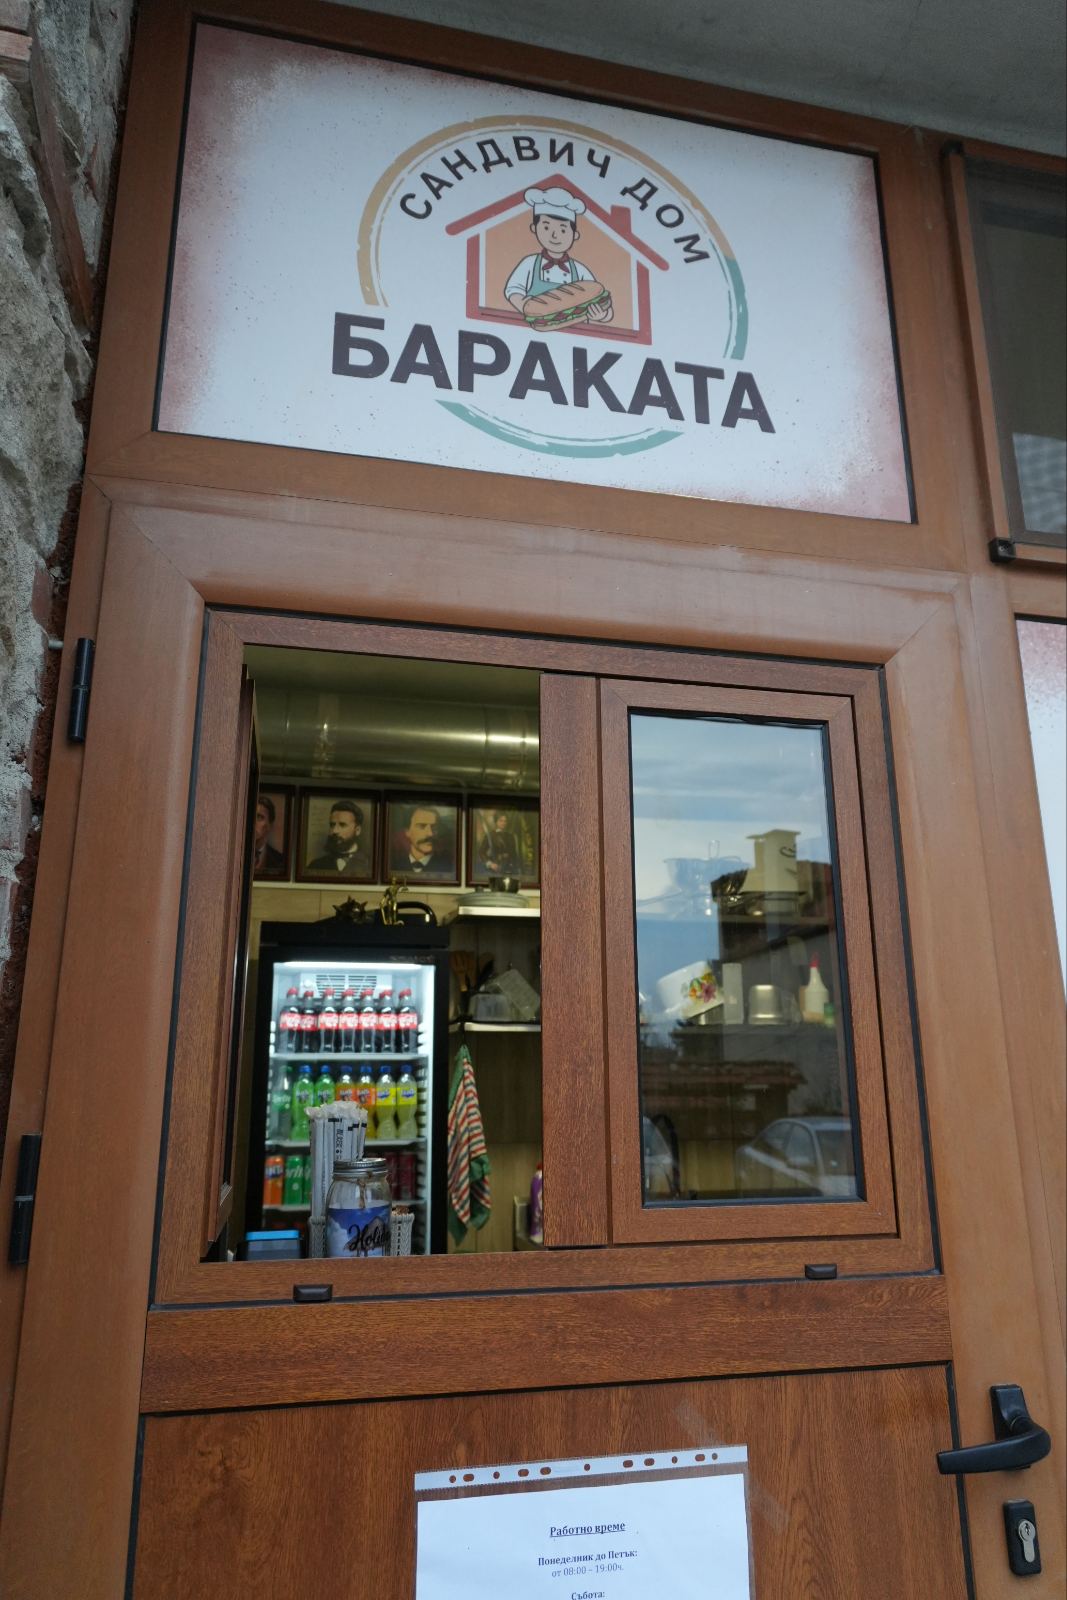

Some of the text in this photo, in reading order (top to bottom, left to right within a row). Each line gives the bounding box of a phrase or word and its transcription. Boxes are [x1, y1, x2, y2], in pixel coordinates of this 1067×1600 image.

[400, 136, 710, 264] САНДВИЧ ДОМ
[332, 312, 776, 434] БАРАКАТА
[550, 1522, 626, 1538] Работно време
[538, 1550, 638, 1566] Понеделник до Петък:
[563, 1566, 586, 1576] 08:00
[571, 1591, 605, 1600] Събота:
